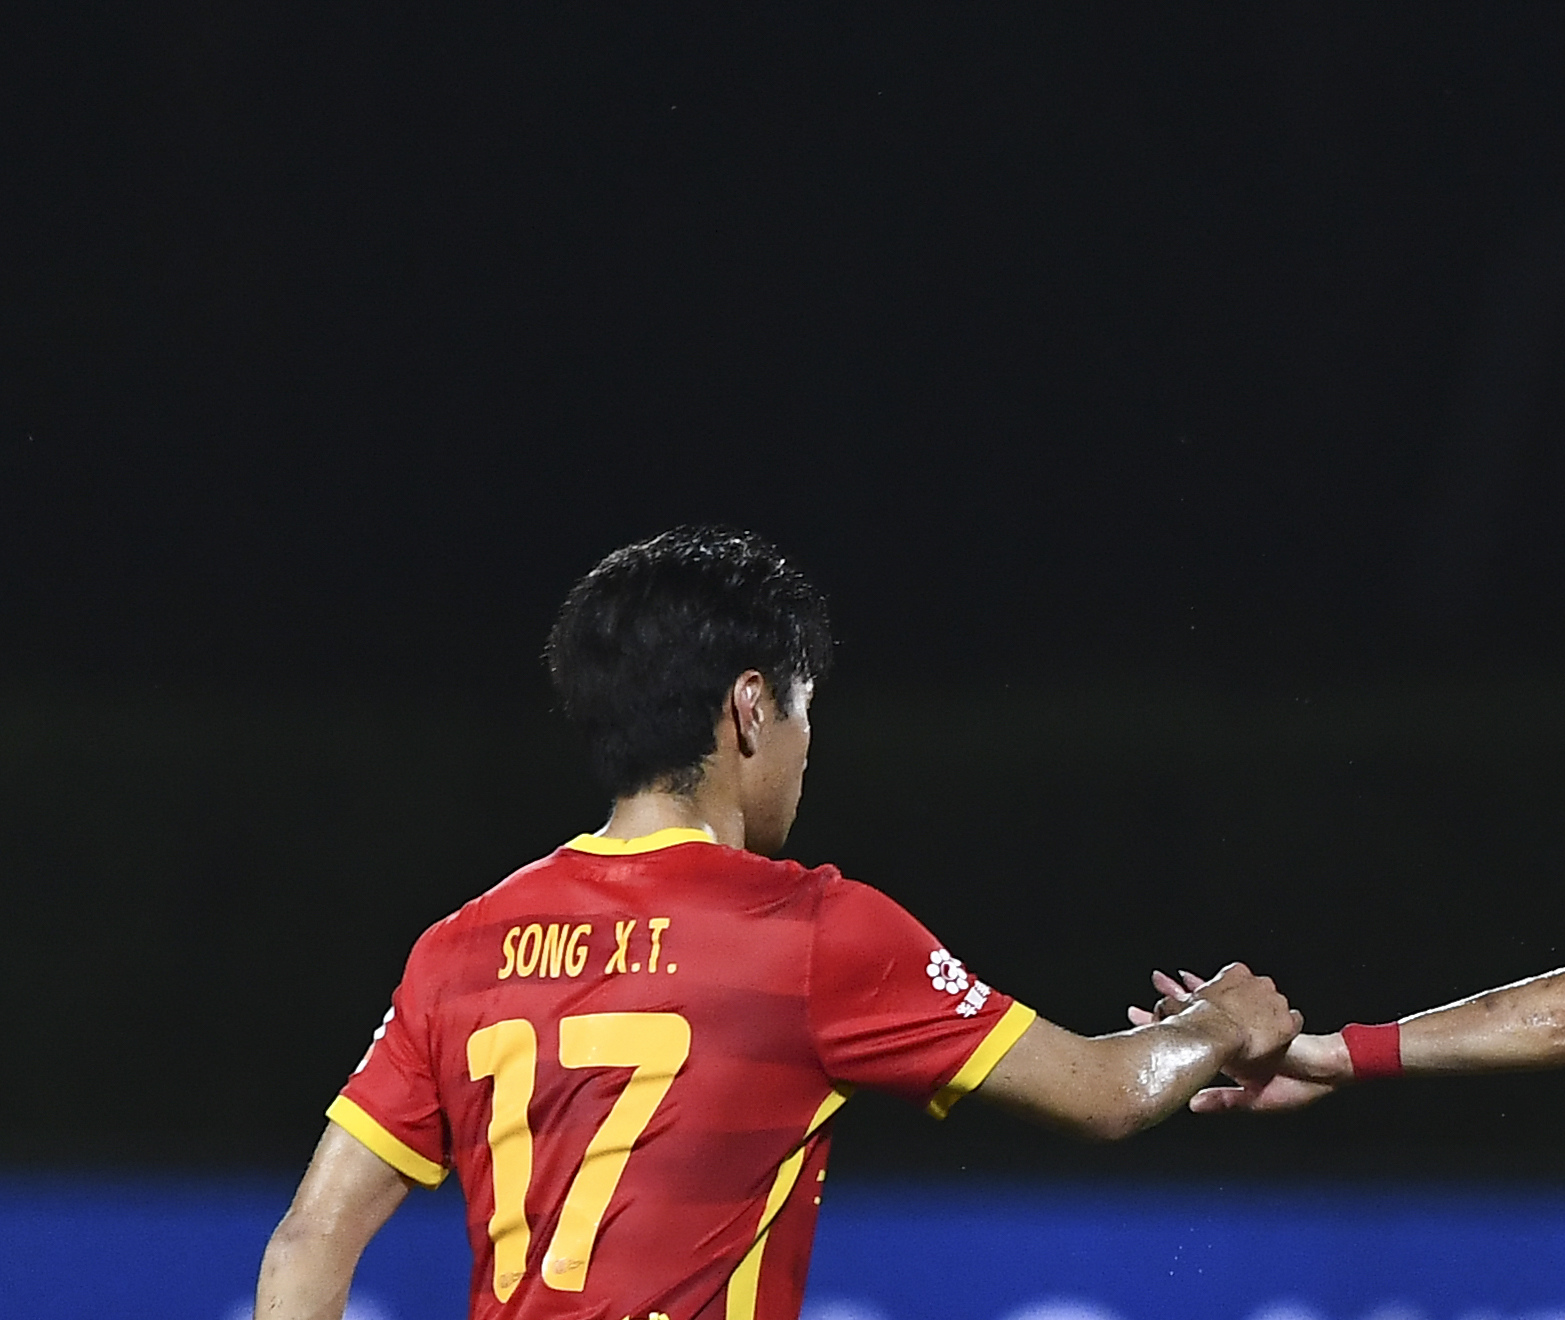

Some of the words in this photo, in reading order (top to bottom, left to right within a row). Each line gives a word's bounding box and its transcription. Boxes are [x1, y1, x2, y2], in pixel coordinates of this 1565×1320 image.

[498, 923, 592, 980] SONG
[604, 917, 677, 974] X.T.
[466, 1012, 692, 1304] 17
